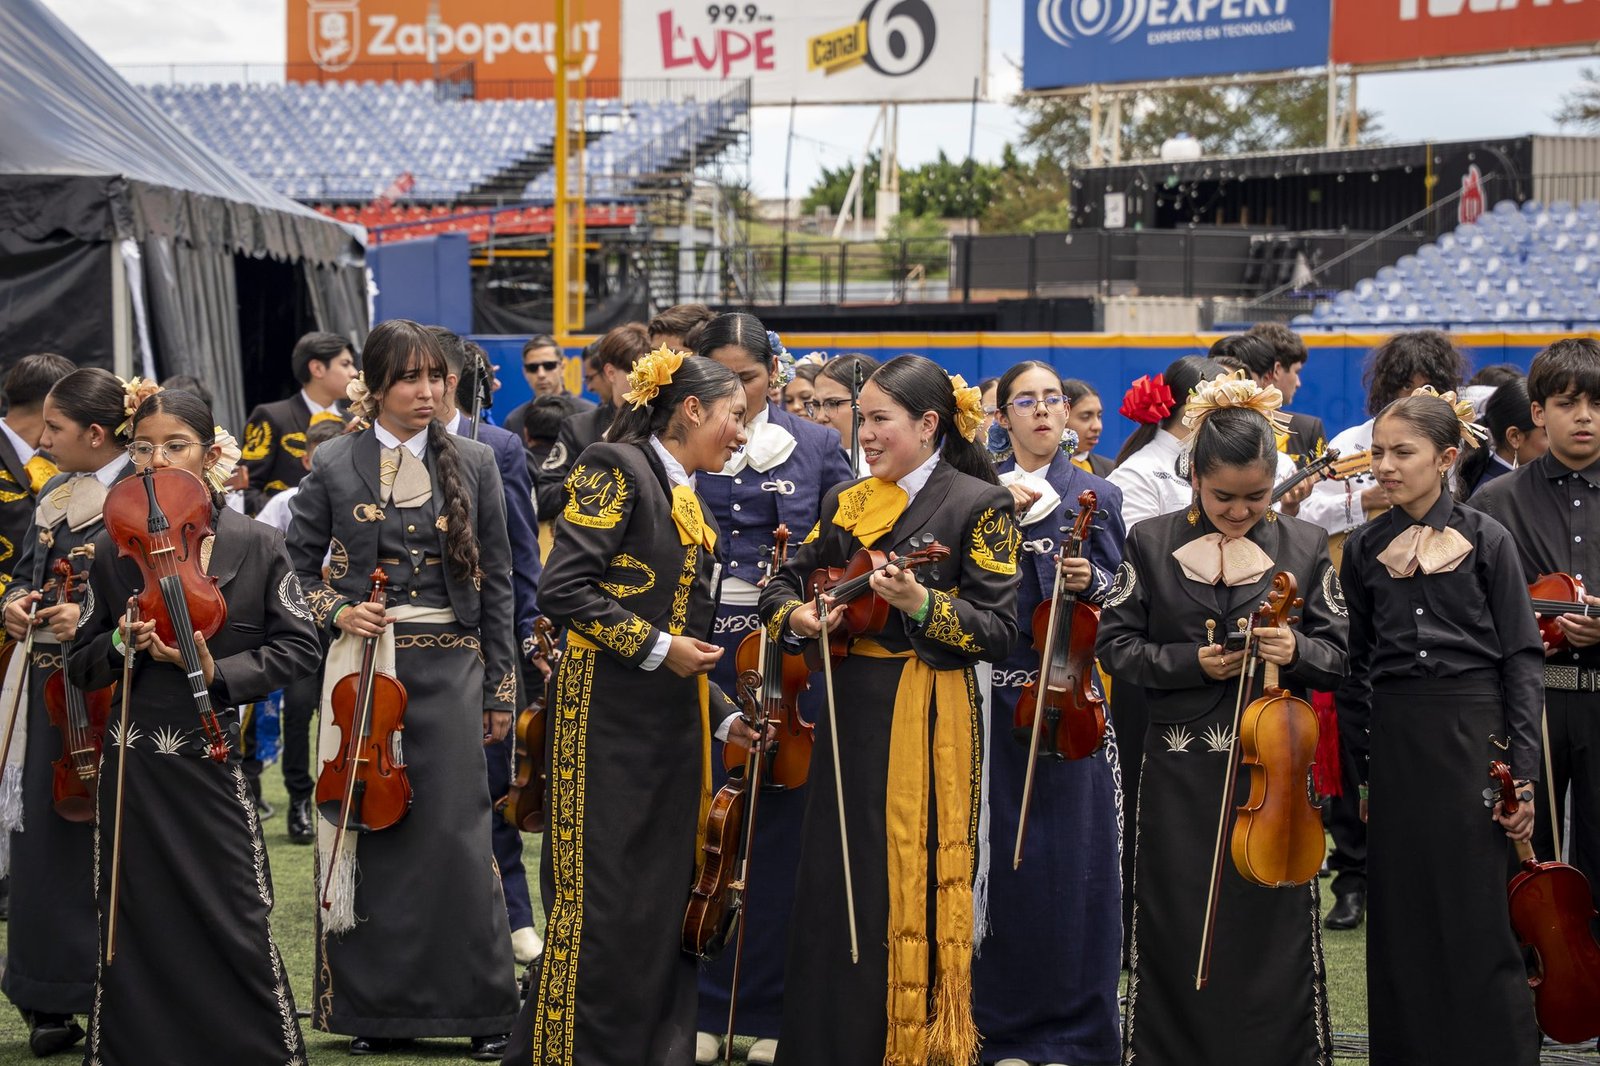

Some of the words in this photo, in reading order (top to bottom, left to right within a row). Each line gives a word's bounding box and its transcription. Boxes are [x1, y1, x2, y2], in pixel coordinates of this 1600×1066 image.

[707, 4, 758, 24] 99.9
[1146, 26, 1203, 45] EXPERTOS
[1203, 25, 1221, 40] EN
[1222, 17, 1295, 38] TECNOLOGÍA
[366, 14, 601, 64] Zapopan
[812, 24, 860, 66] Canal
[864, 0, 934, 76] 6
